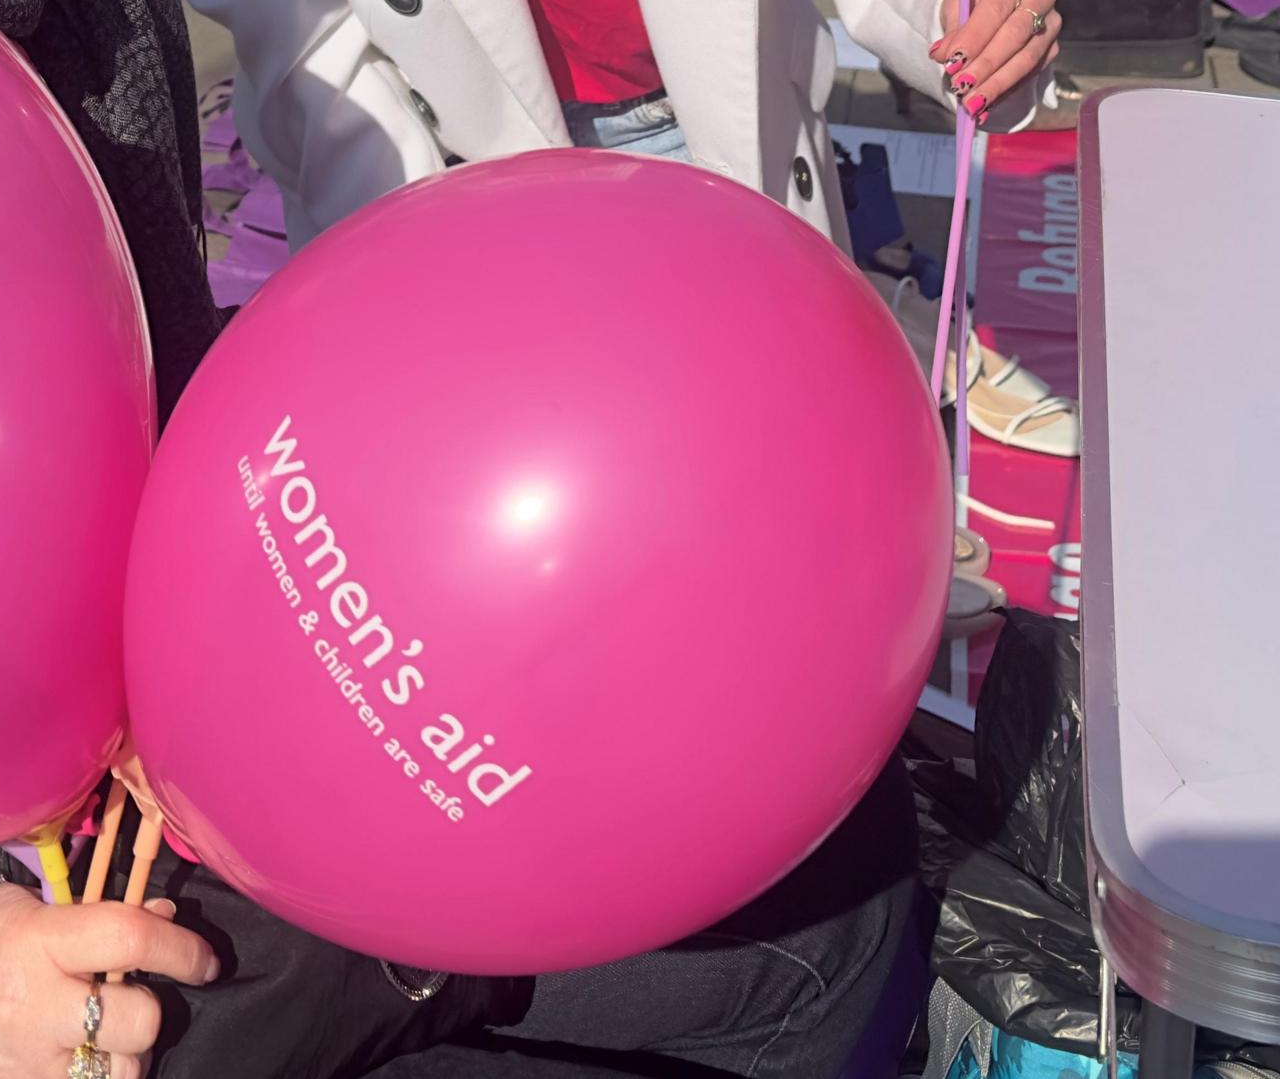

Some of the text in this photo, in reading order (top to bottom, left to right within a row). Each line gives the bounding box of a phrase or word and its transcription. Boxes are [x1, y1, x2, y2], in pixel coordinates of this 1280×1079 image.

[237, 455, 465, 823] until women & children are safe
[263, 414, 532, 807] women's aid
